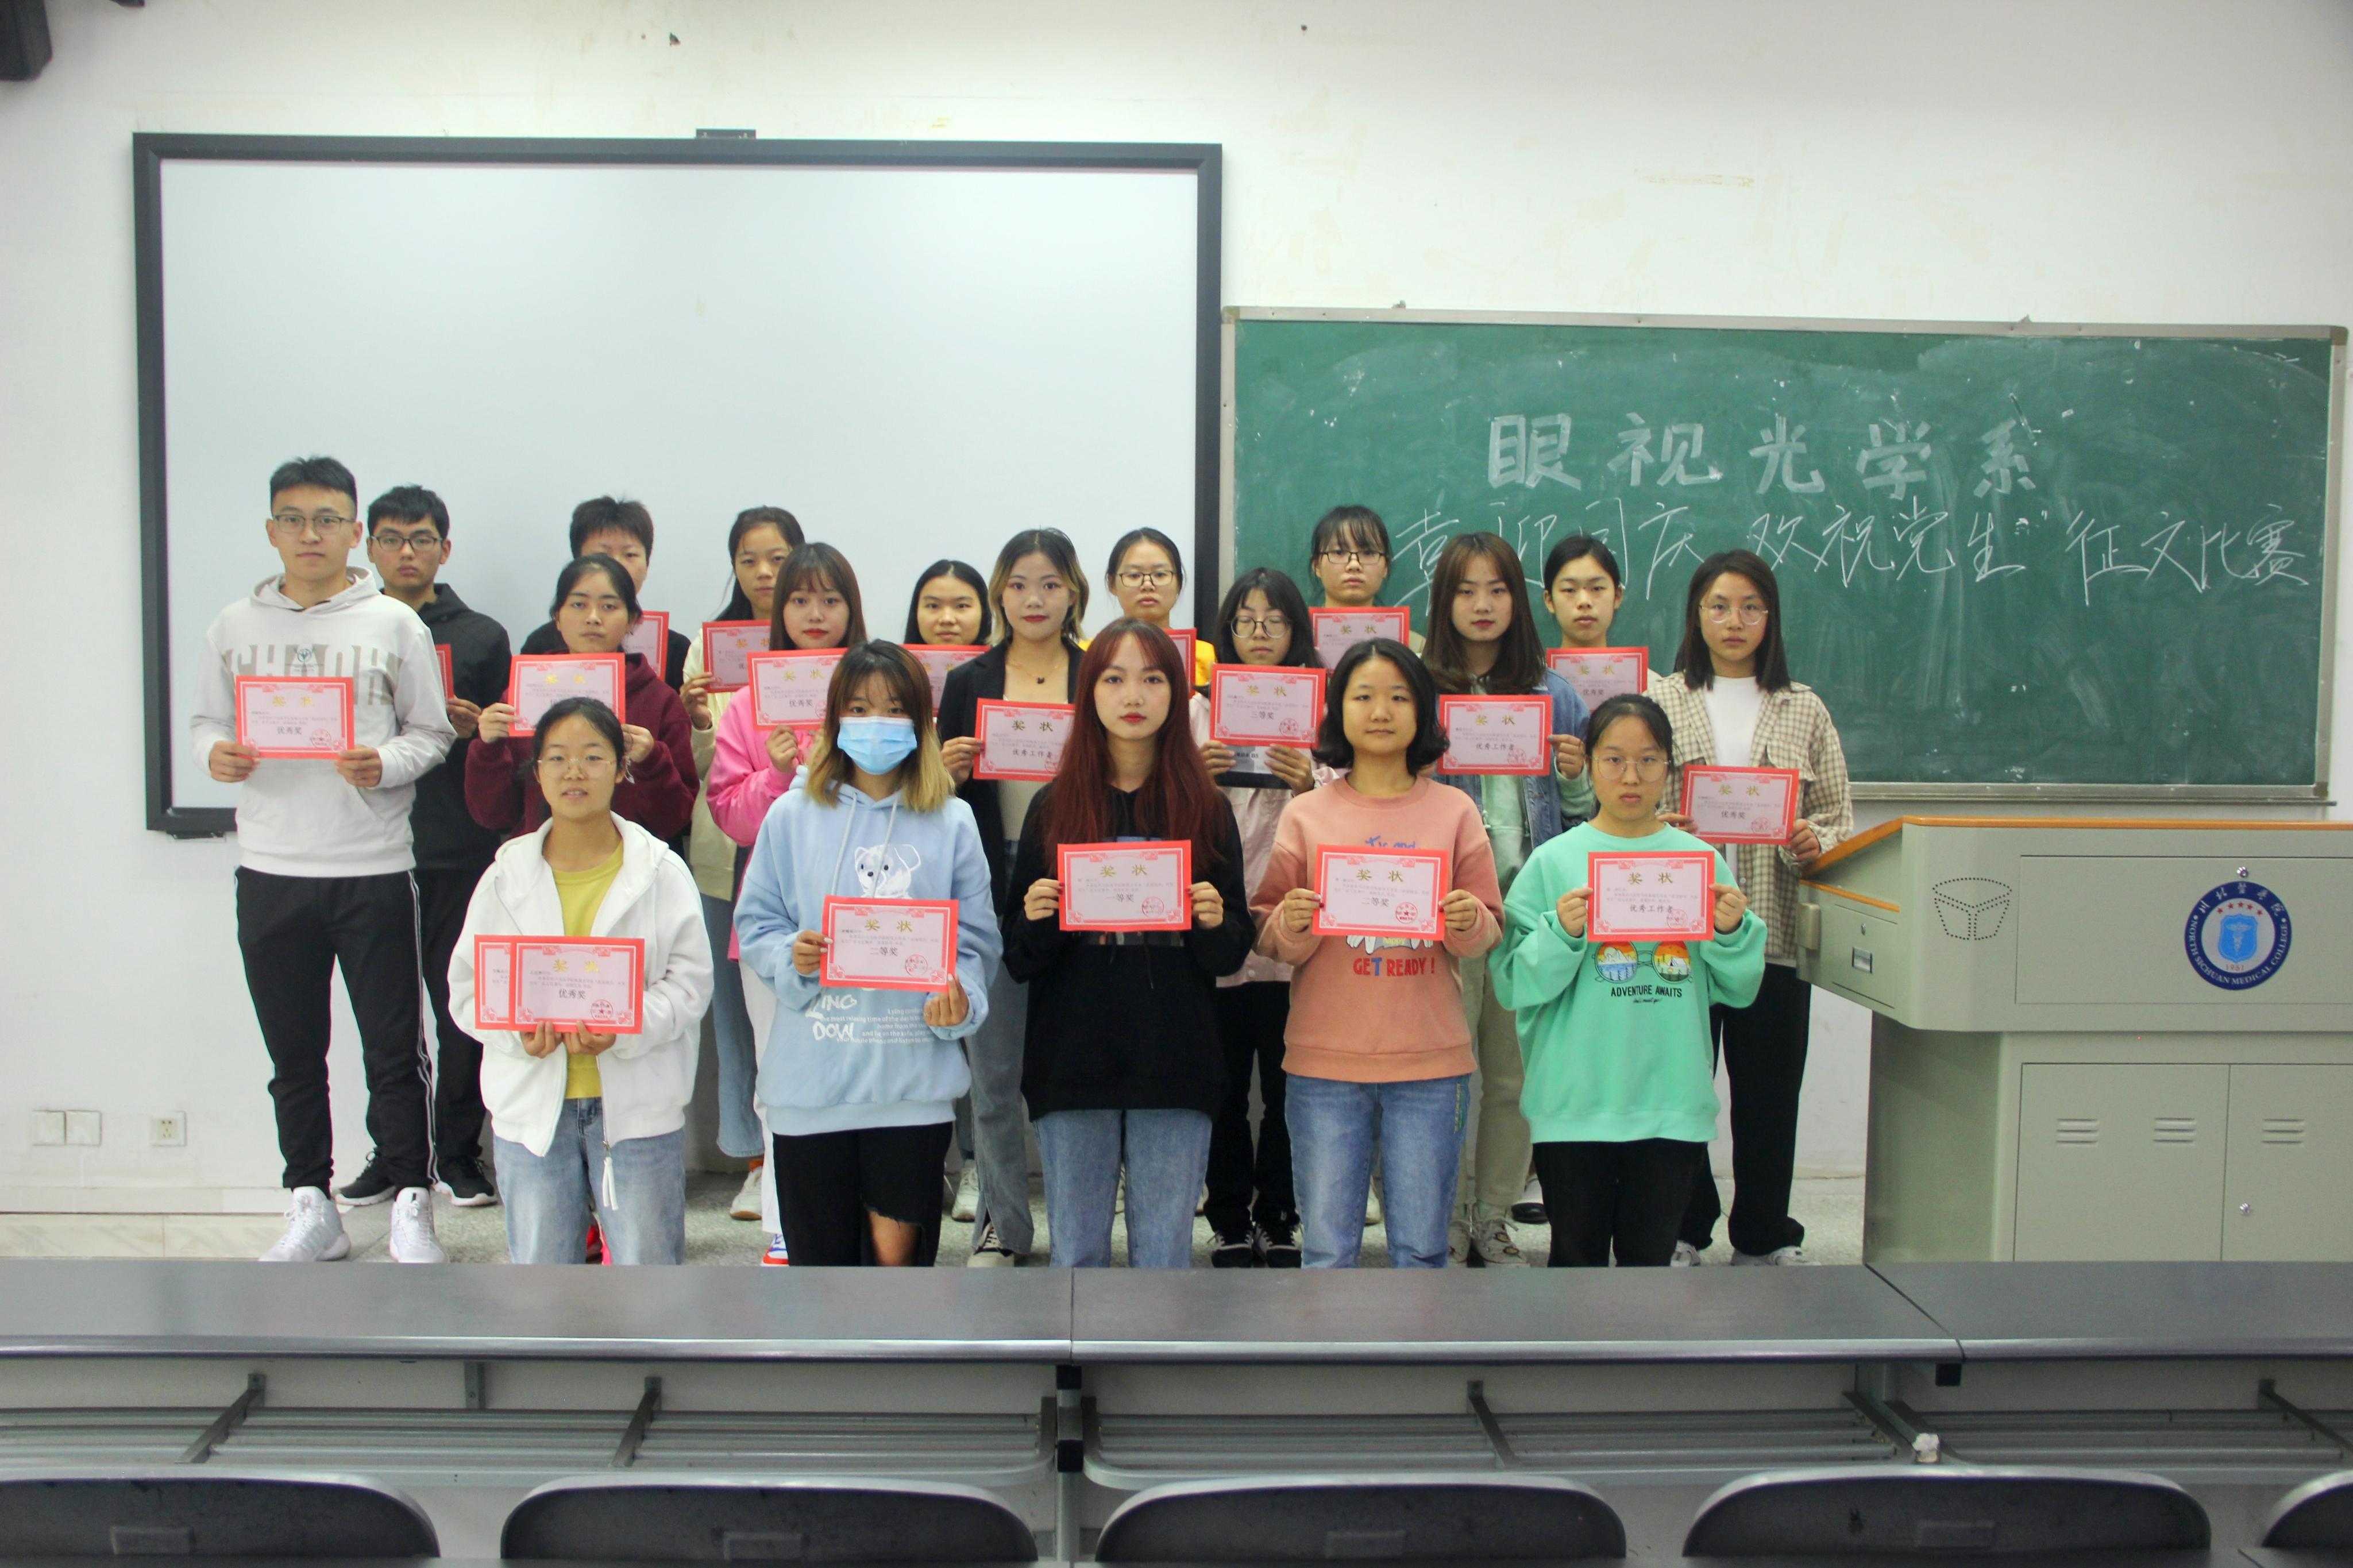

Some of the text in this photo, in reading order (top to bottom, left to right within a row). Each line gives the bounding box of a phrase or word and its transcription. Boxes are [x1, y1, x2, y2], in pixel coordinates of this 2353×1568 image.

[1487, 412, 2036, 501] 眼视光学系
[1340, 624, 1376, 635] 奖状
[783, 669, 824, 681] 奖状
[1579, 665, 1615, 675] 奖状
[1247, 685, 1287, 697] 奖状
[272, 695, 315, 707] 奖状
[788, 698, 813, 708] 优秀奖
[1250, 710, 1274, 720] 三等奖
[1475, 714, 1515, 725] 奖状
[277, 725, 303, 736] 优秀奖
[1012, 720, 1054, 732] 奖状
[1476, 743, 1515, 751] 优秀工作者
[1013, 748, 1052, 759] 优秀工作者
[1718, 785, 1760, 796] 奖状
[1721, 811, 1746, 820] 优秀奖
[1100, 864, 1148, 878] 奖状
[1356, 868, 1404, 883] 奖状
[1627, 872, 1673, 885] 奖状
[1106, 893, 1134, 903] 一等奖
[1361, 897, 1389, 907] 二等奖
[1630, 903, 1674, 913] 优秀工作者
[864, 918, 913, 933] 奖状
[869, 947, 898, 957] 二等奖
[2189, 920, 2288, 985] NORTH SICHUAN MEDICAL COLLEGE
[553, 959, 600, 972] 奖状
[1353, 956, 1382, 976] GET
[1386, 957, 1426, 977] READY
[559, 988, 586, 1000] 优秀奖
[1611, 984, 1683, 998] ADVENTURE AWAITS
